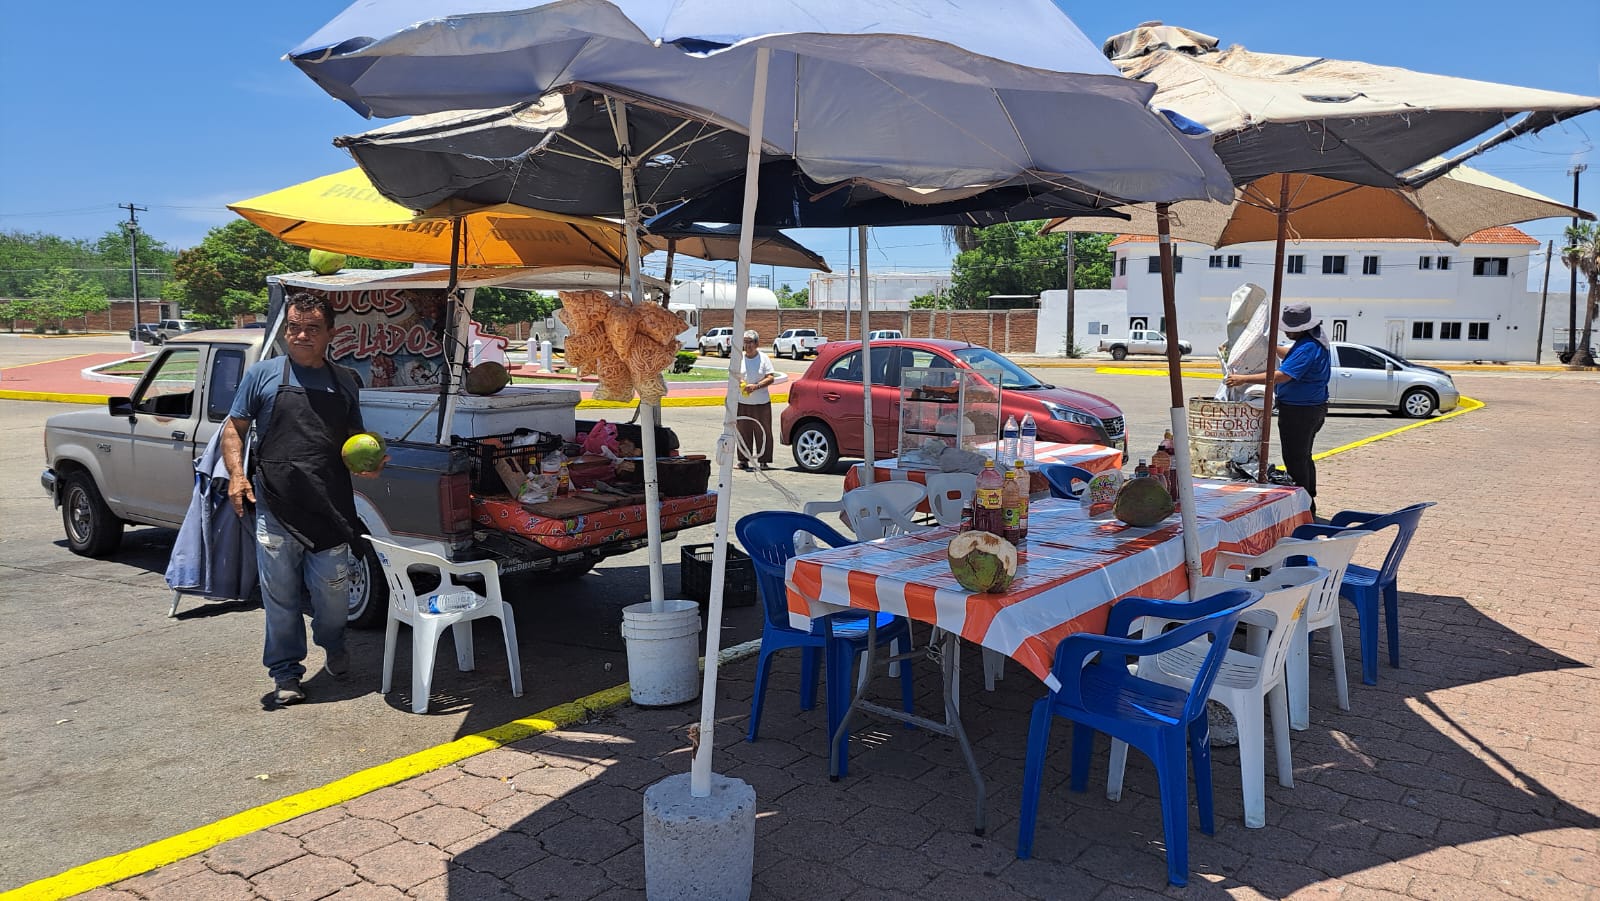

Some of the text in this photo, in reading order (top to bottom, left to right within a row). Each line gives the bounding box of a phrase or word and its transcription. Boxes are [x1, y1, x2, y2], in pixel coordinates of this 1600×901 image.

[324, 289, 406, 316] OCOS
[329, 321, 444, 361] ELADOS
[1200, 404, 1261, 419] CENTRO
